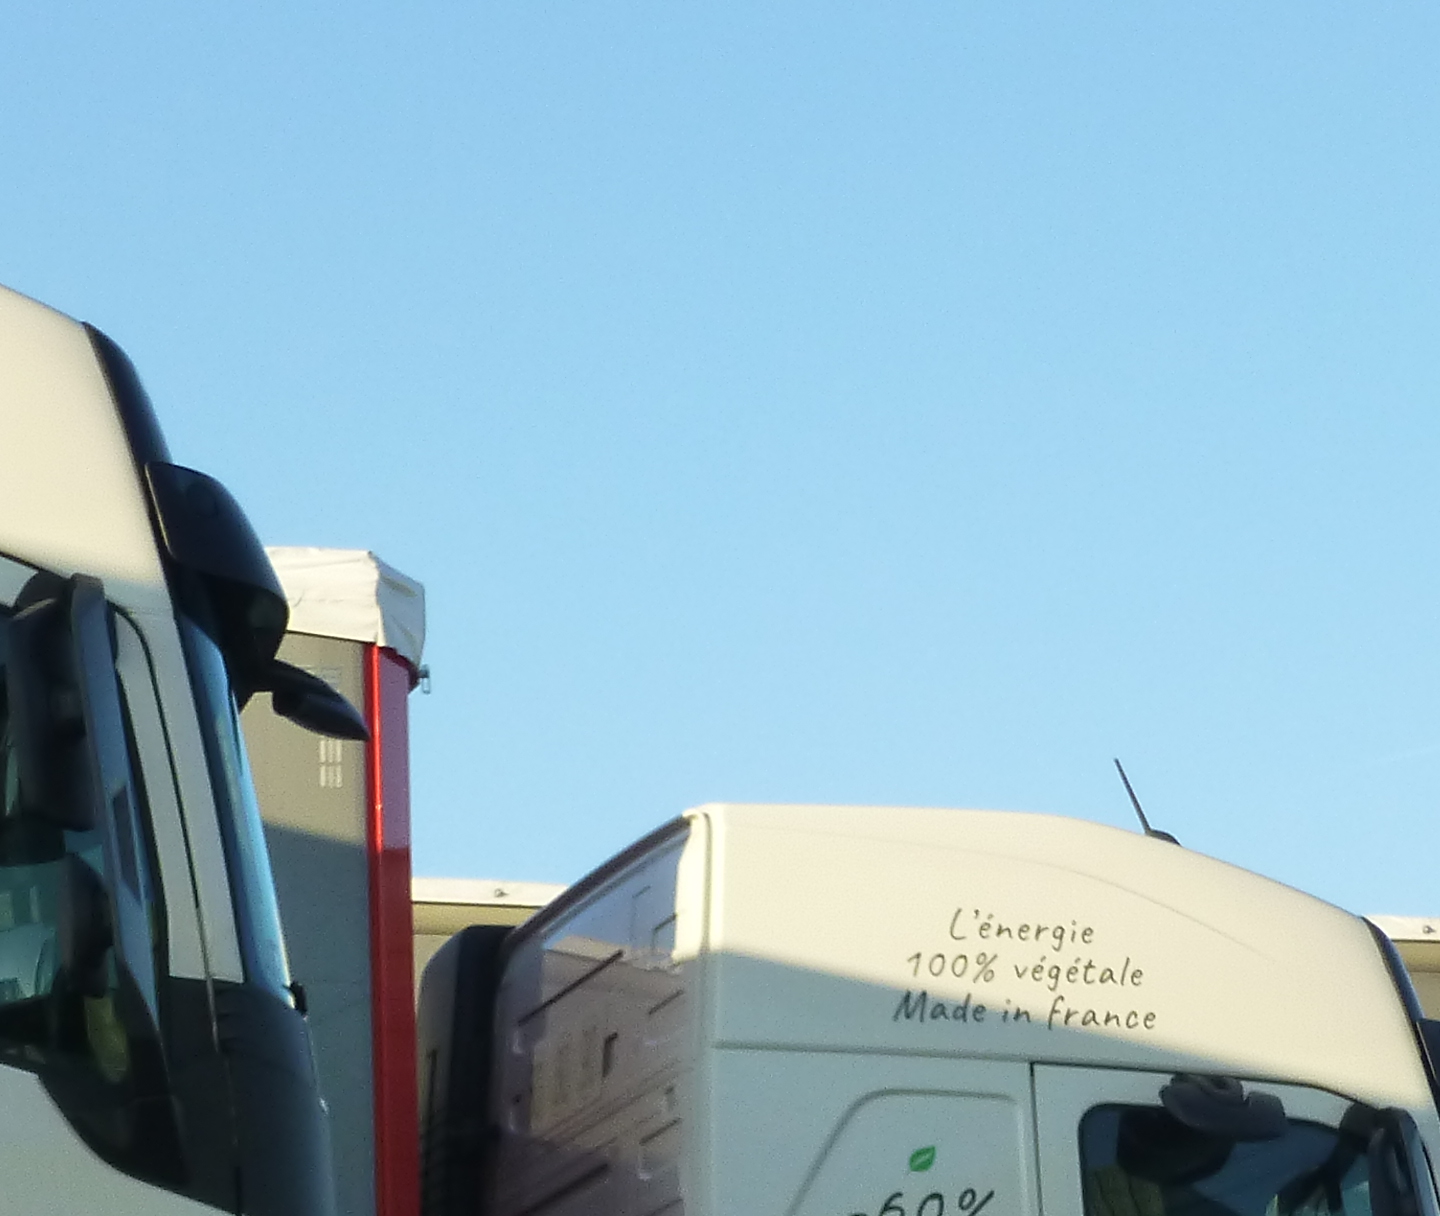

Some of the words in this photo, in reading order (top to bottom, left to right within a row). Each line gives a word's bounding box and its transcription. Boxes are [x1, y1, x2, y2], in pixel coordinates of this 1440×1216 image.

[949, 907, 1095, 953] L'énergie
[905, 951, 996, 983] 100%
[1014, 956, 1145, 993] végétale
[892, 990, 987, 1024] Made
[1001, 999, 1033, 1025] in
[1046, 995, 1157, 1031] france
